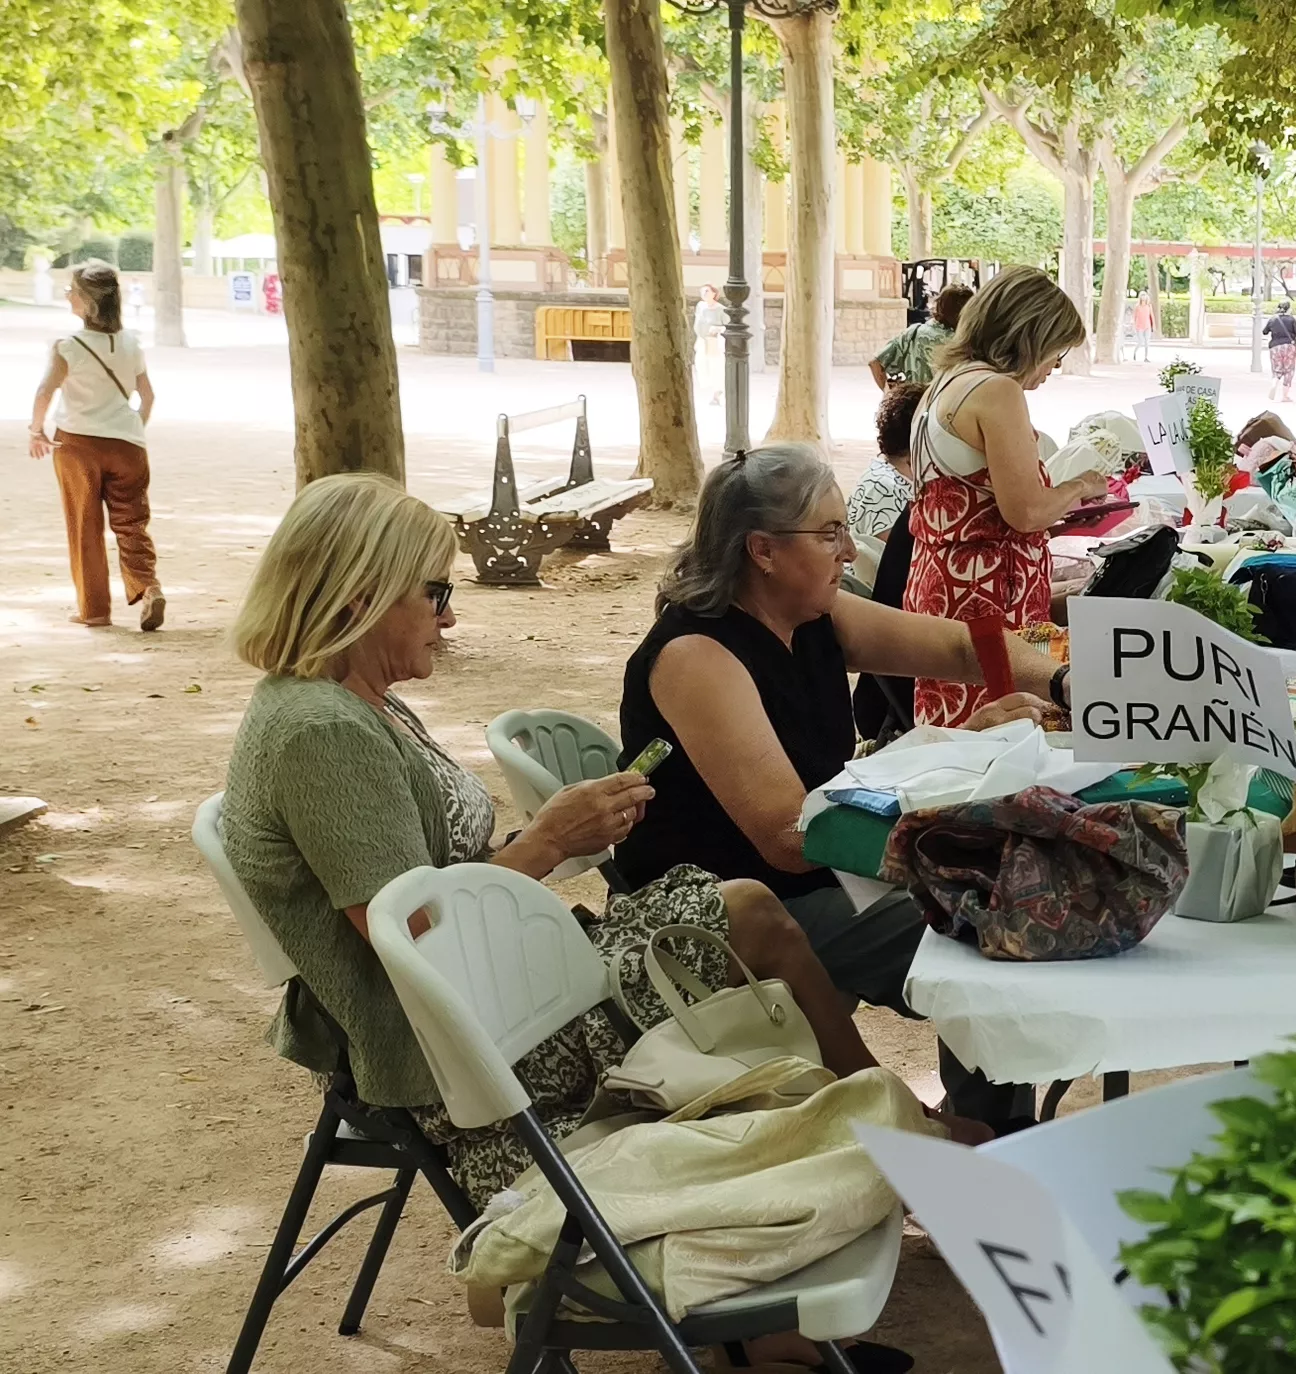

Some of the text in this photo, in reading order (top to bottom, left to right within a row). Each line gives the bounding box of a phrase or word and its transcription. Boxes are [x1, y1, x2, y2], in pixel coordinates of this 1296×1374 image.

[1186, 385, 1196, 395] DE
[1197, 387, 1217, 397] CASA
[1112, 627, 1261, 708] PURI
